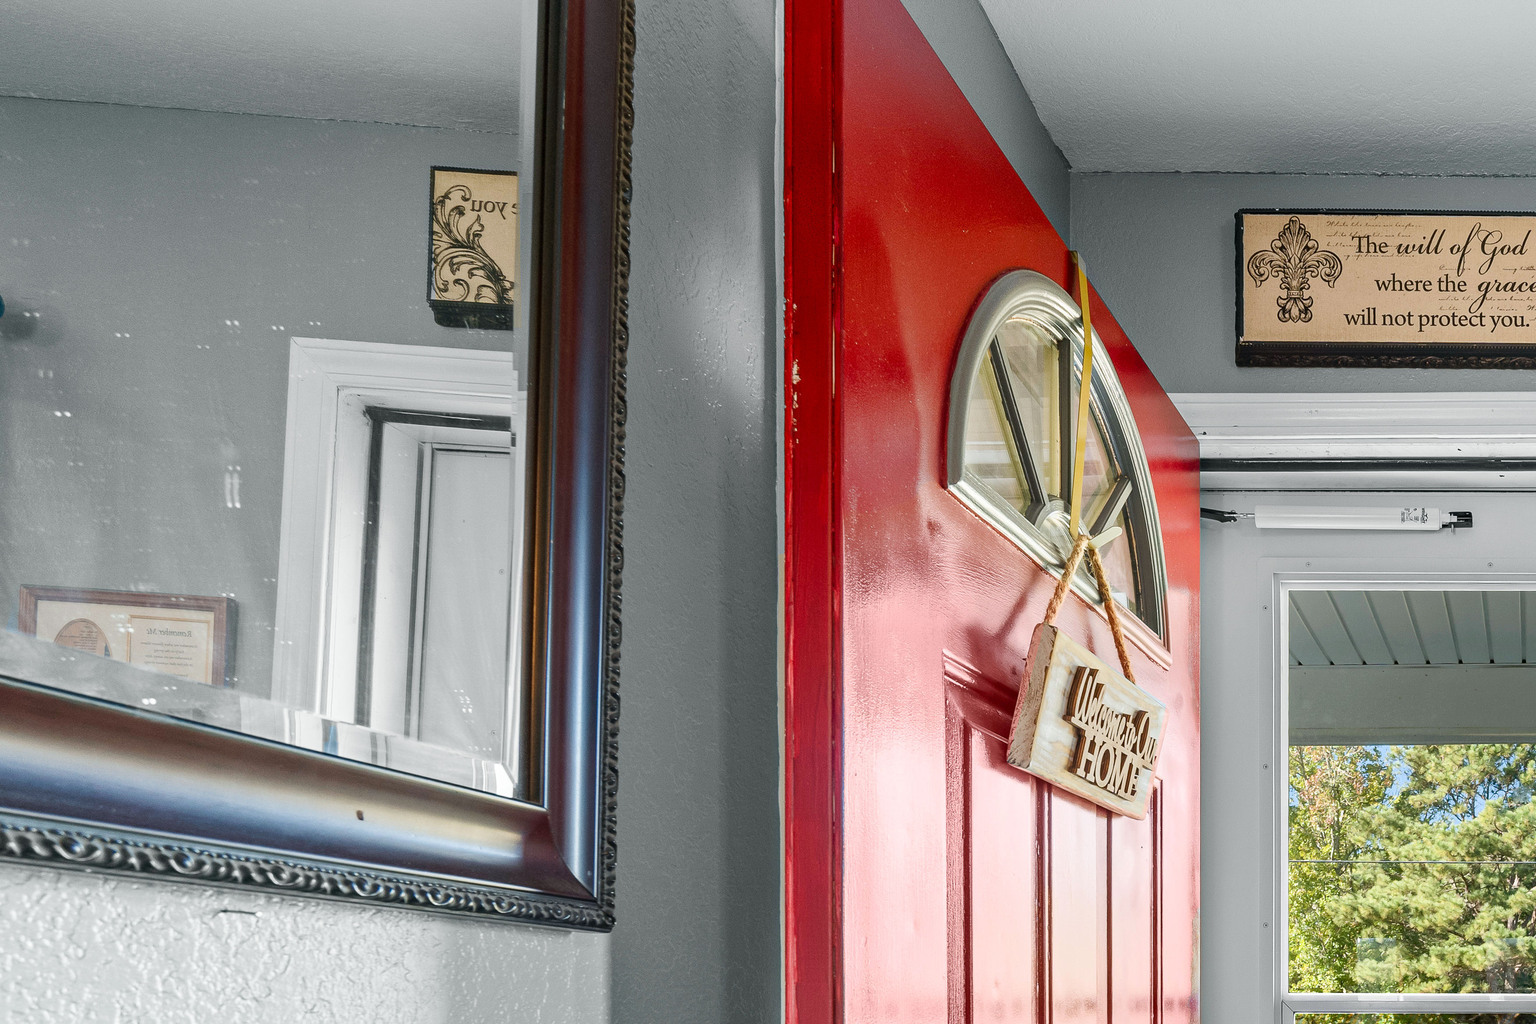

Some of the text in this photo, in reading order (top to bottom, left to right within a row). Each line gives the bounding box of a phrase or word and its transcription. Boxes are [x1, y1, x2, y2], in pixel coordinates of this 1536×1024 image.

[1351, 235, 1389, 254] The
[1396, 229, 1446, 256] will
[1449, 222, 1482, 277] of
[1477, 229, 1532, 275] God
[1374, 273, 1433, 292] where
[1437, 274, 1467, 292] the
[1343, 307, 1378, 326] will
[1381, 312, 1414, 327] not
[1418, 312, 1486, 333] protect
[1490, 315, 1531, 333] you.
[1071, 666, 1127, 745] Welcome
[1076, 731, 1141, 800] HOME
